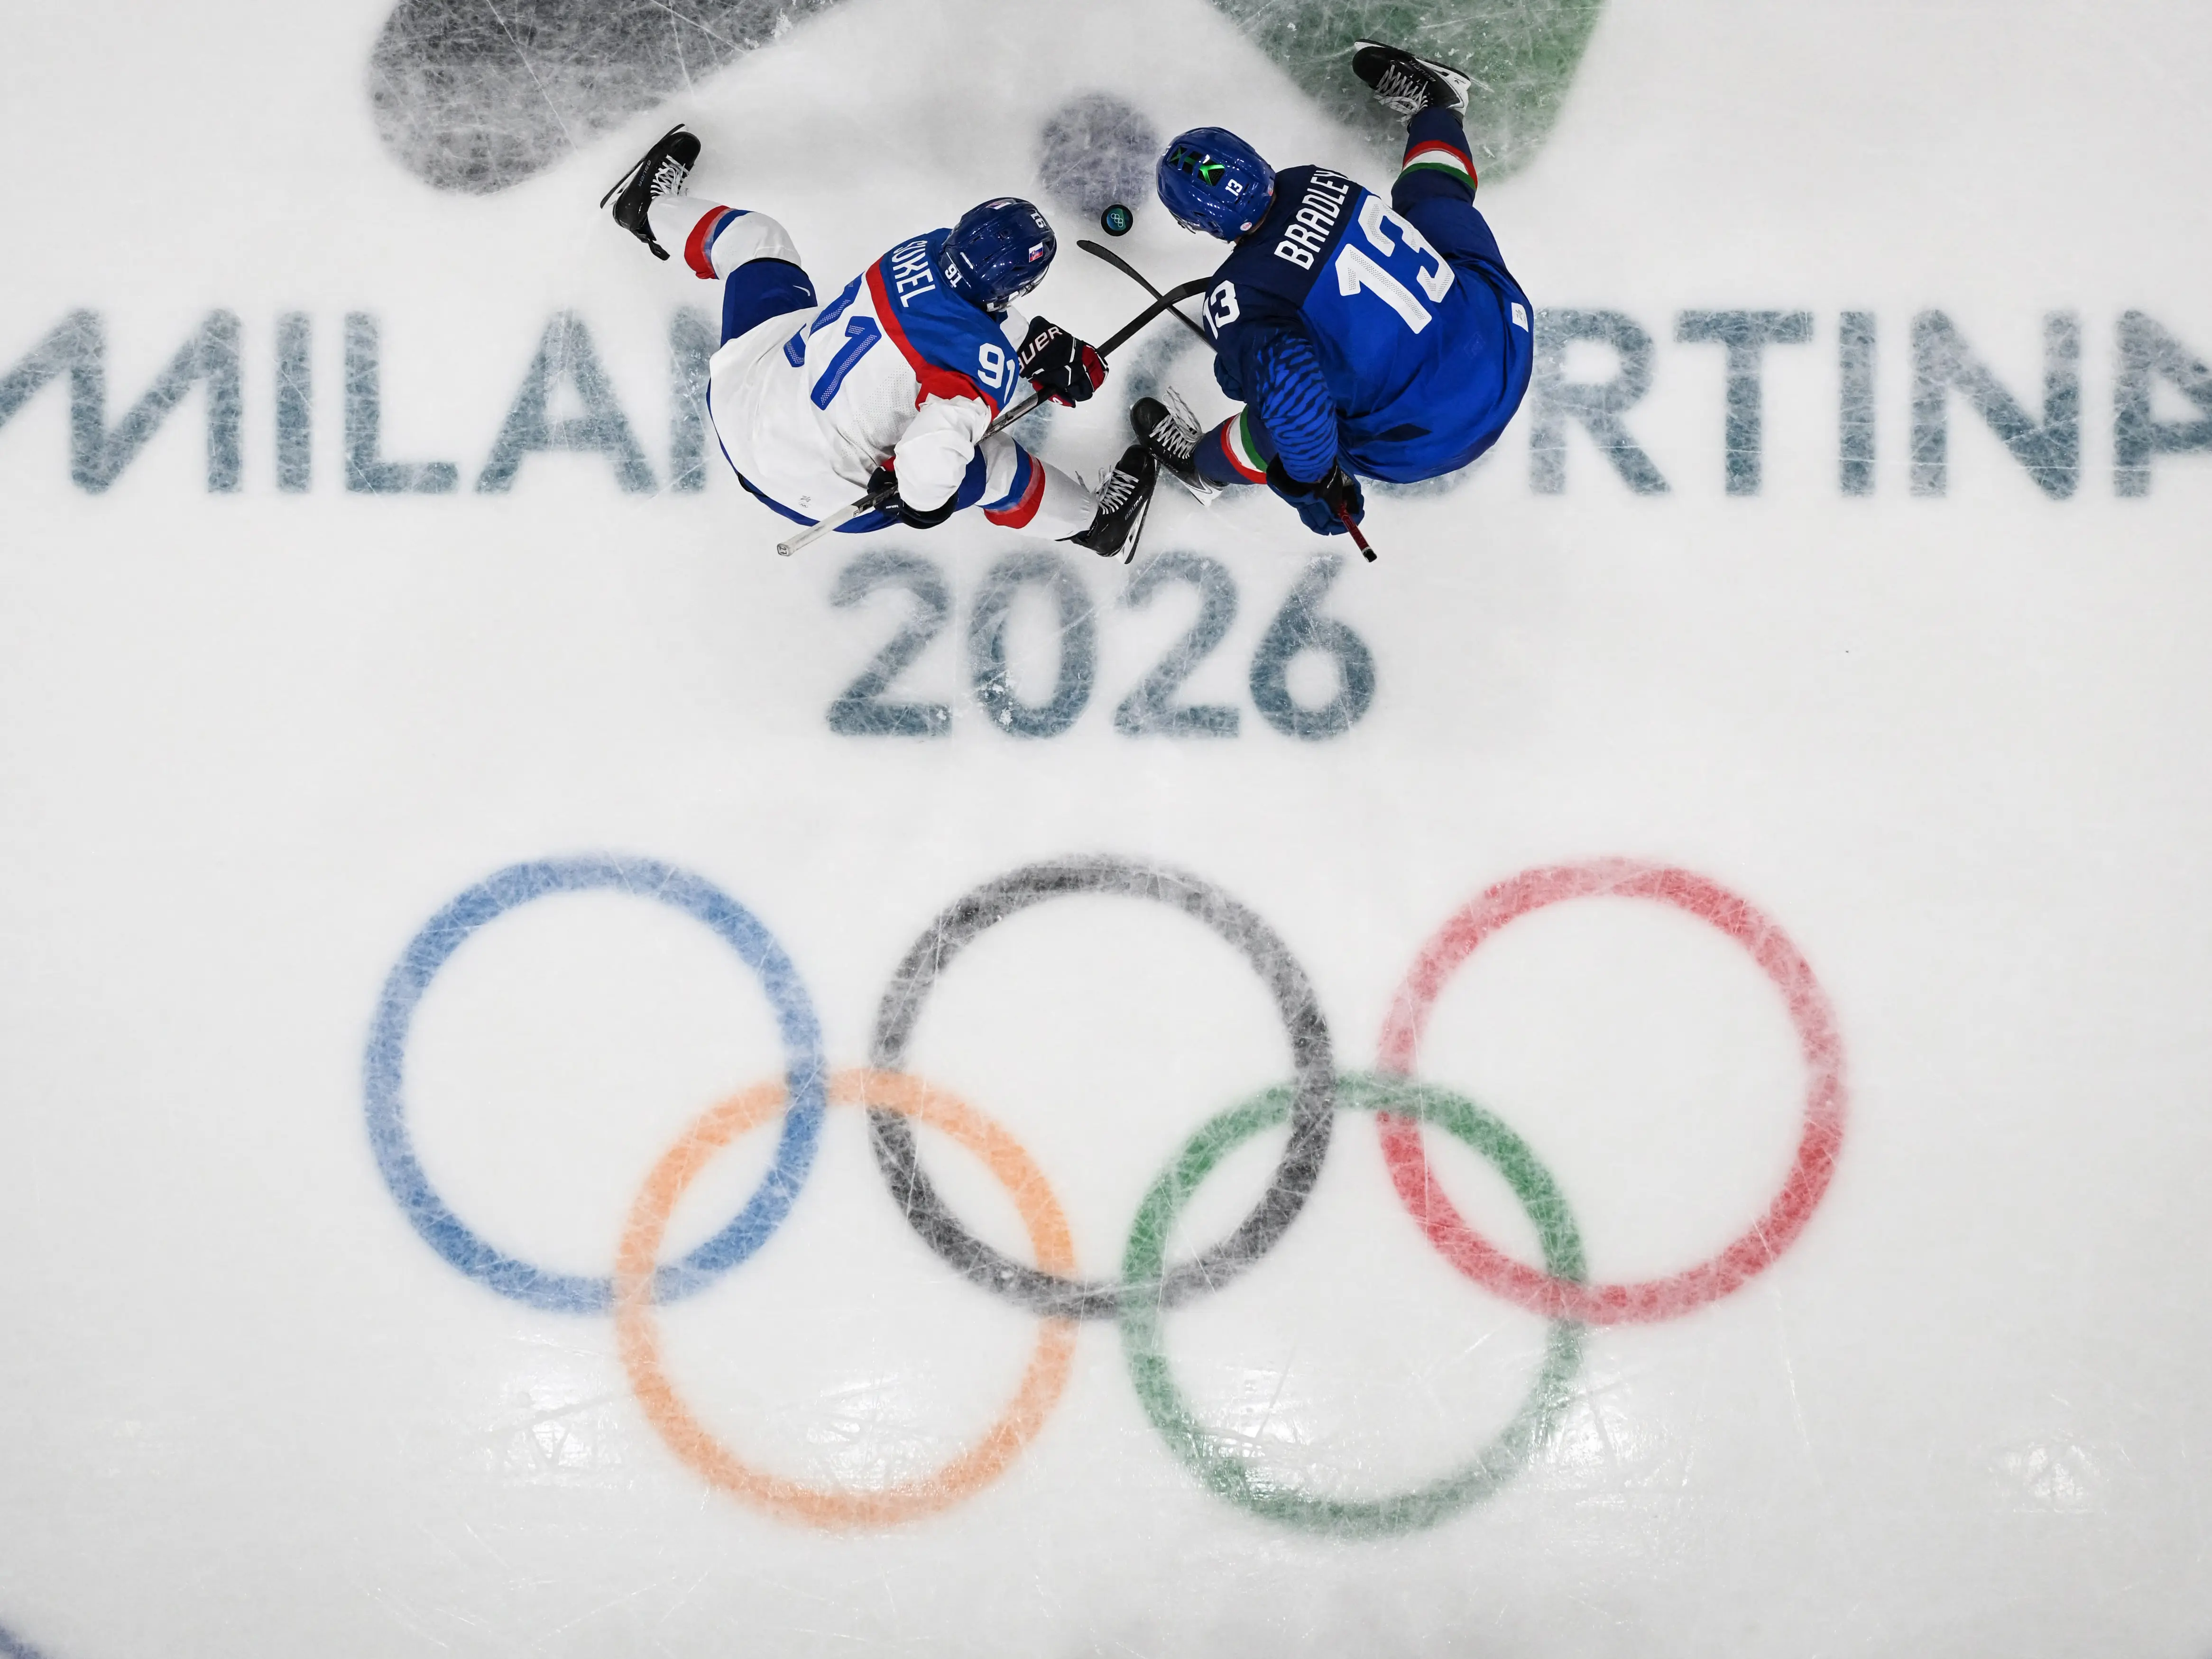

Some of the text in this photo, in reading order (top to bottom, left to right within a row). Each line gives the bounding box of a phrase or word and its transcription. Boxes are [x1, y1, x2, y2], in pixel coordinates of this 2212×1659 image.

[1225, 179, 1243, 196] 13
[1030, 210, 1047, 228] 91
[1274, 170, 1349, 270] BRADLEY
[892, 240, 935, 307] SUKEL
[945, 264, 962, 288] 91
[1335, 195, 1455, 334] 13
[1203, 280, 1240, 339] 13
[977, 343, 1015, 404] 91
[1124, 495, 1143, 521] BAUER
[825, 548, 1376, 741] 2026
